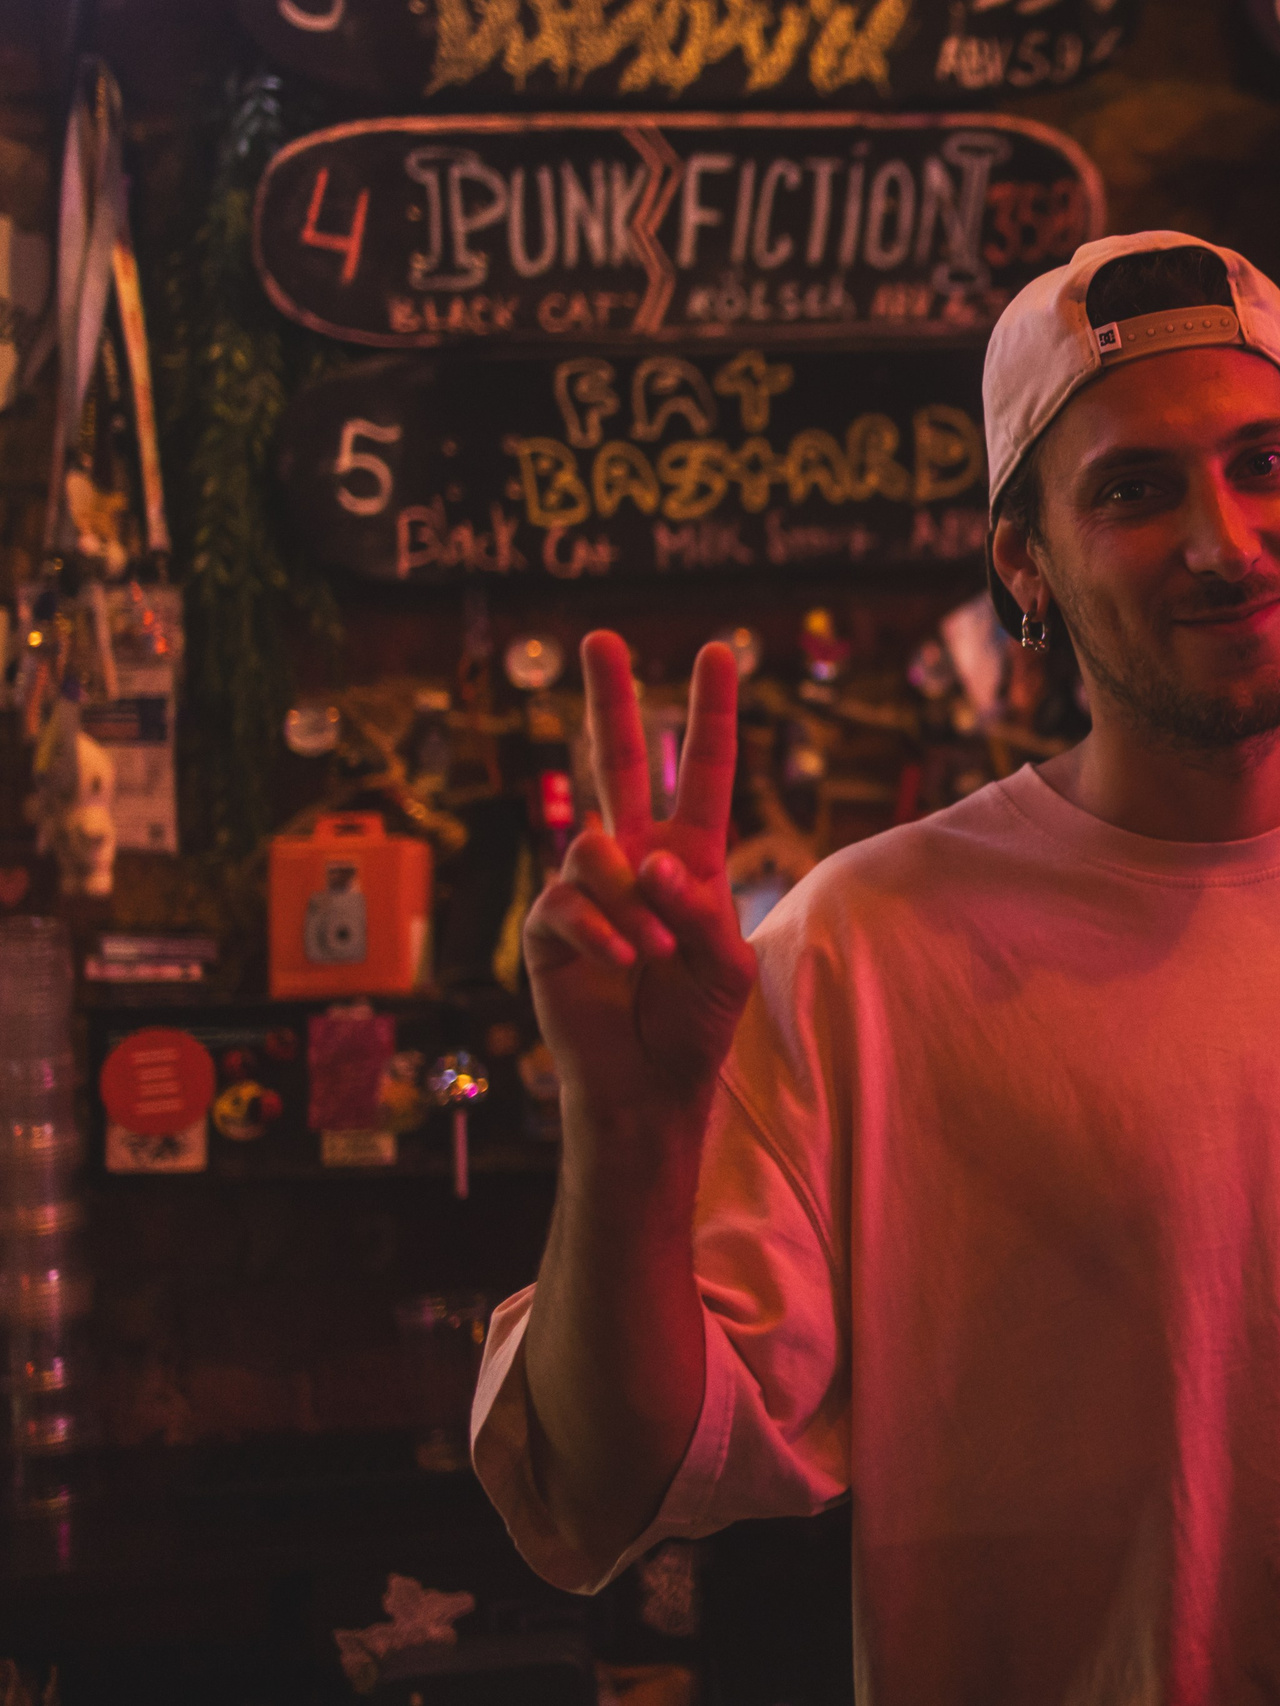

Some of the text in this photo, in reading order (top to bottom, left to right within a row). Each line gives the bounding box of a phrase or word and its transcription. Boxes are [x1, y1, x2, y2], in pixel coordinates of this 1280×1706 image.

[302, 166, 372, 286] 4
[404, 144, 648, 292] PUNK
[554, 350, 795, 450] FAT
[335, 416, 402, 517] 5
